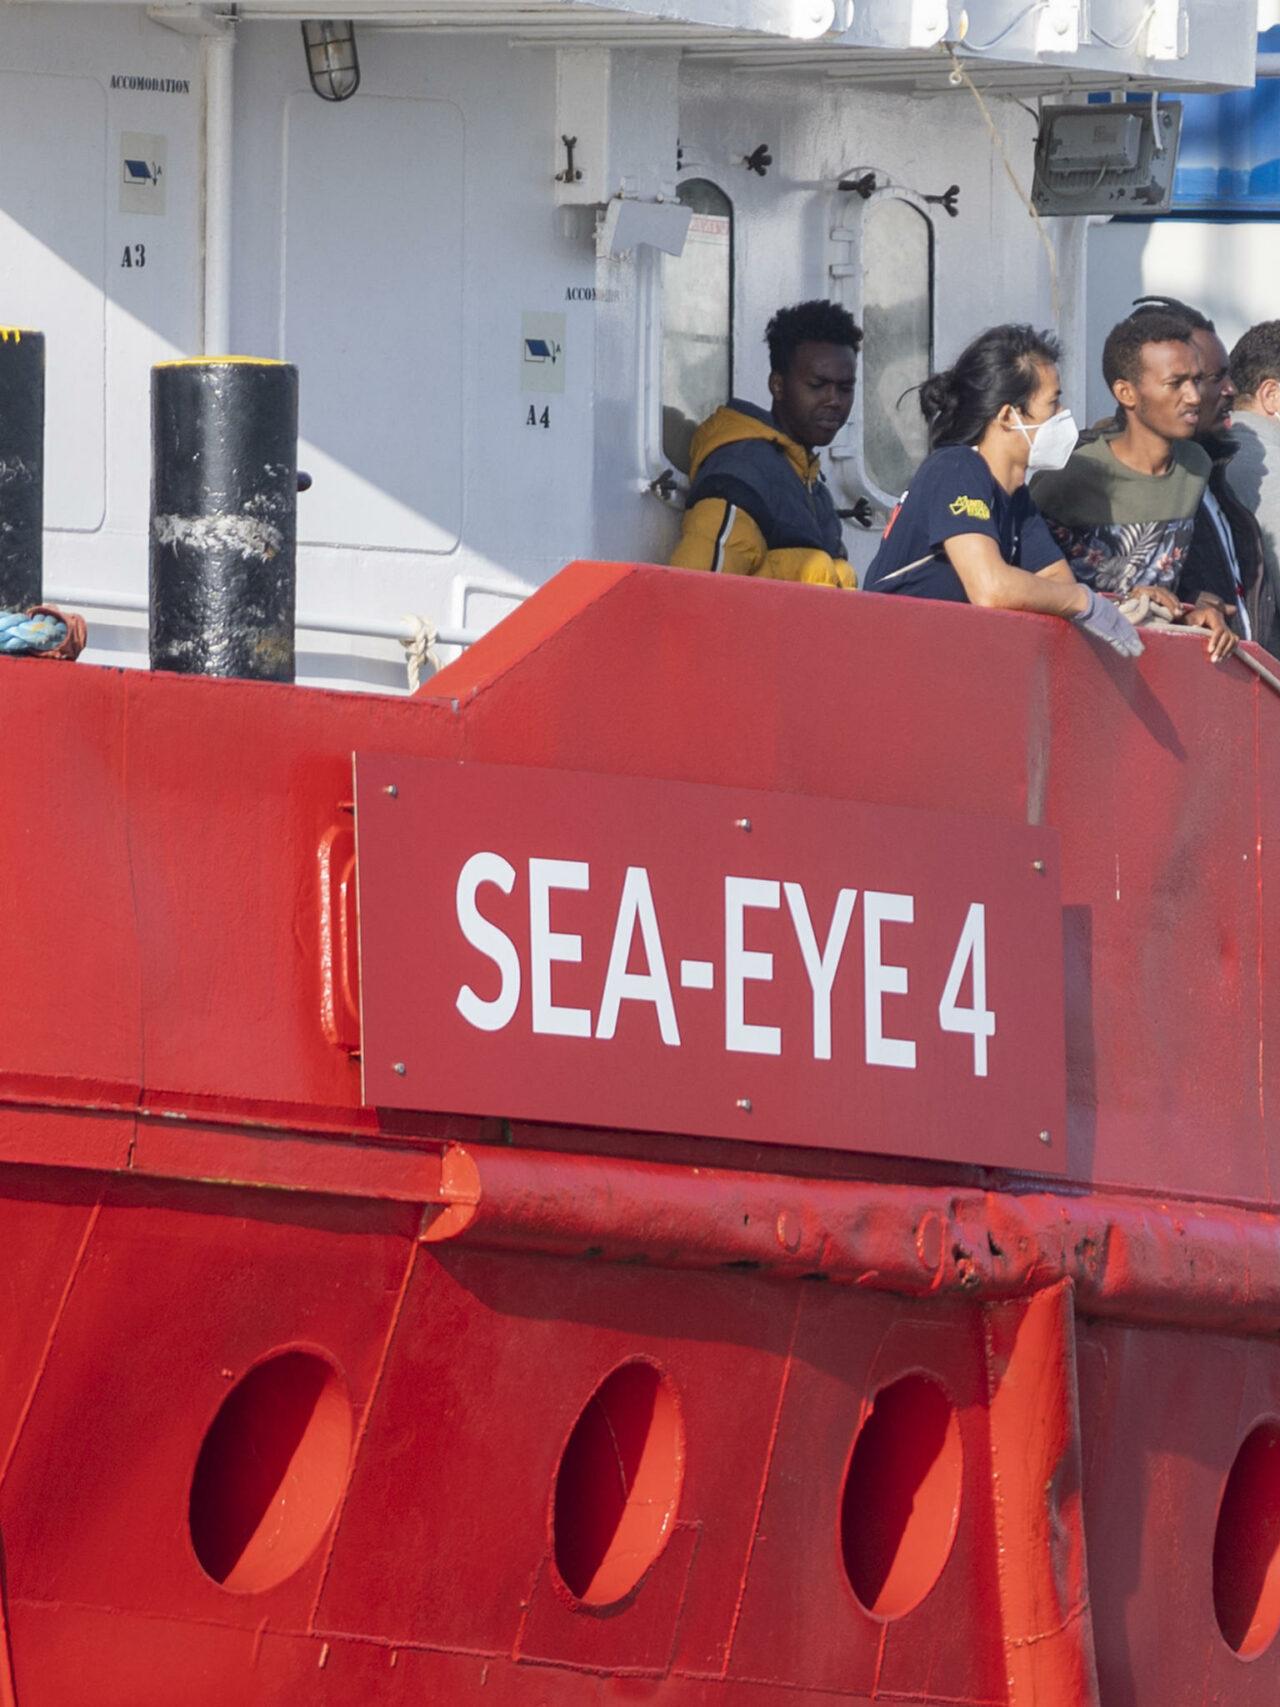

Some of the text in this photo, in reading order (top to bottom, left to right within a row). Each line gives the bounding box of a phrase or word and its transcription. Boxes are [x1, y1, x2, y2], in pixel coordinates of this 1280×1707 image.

[110, 74, 191, 94] ACCOMODATION
[121, 243, 146, 268] A3
[526, 404, 550, 428] A4
[456, 851, 996, 1077] SEA-EYE 4
